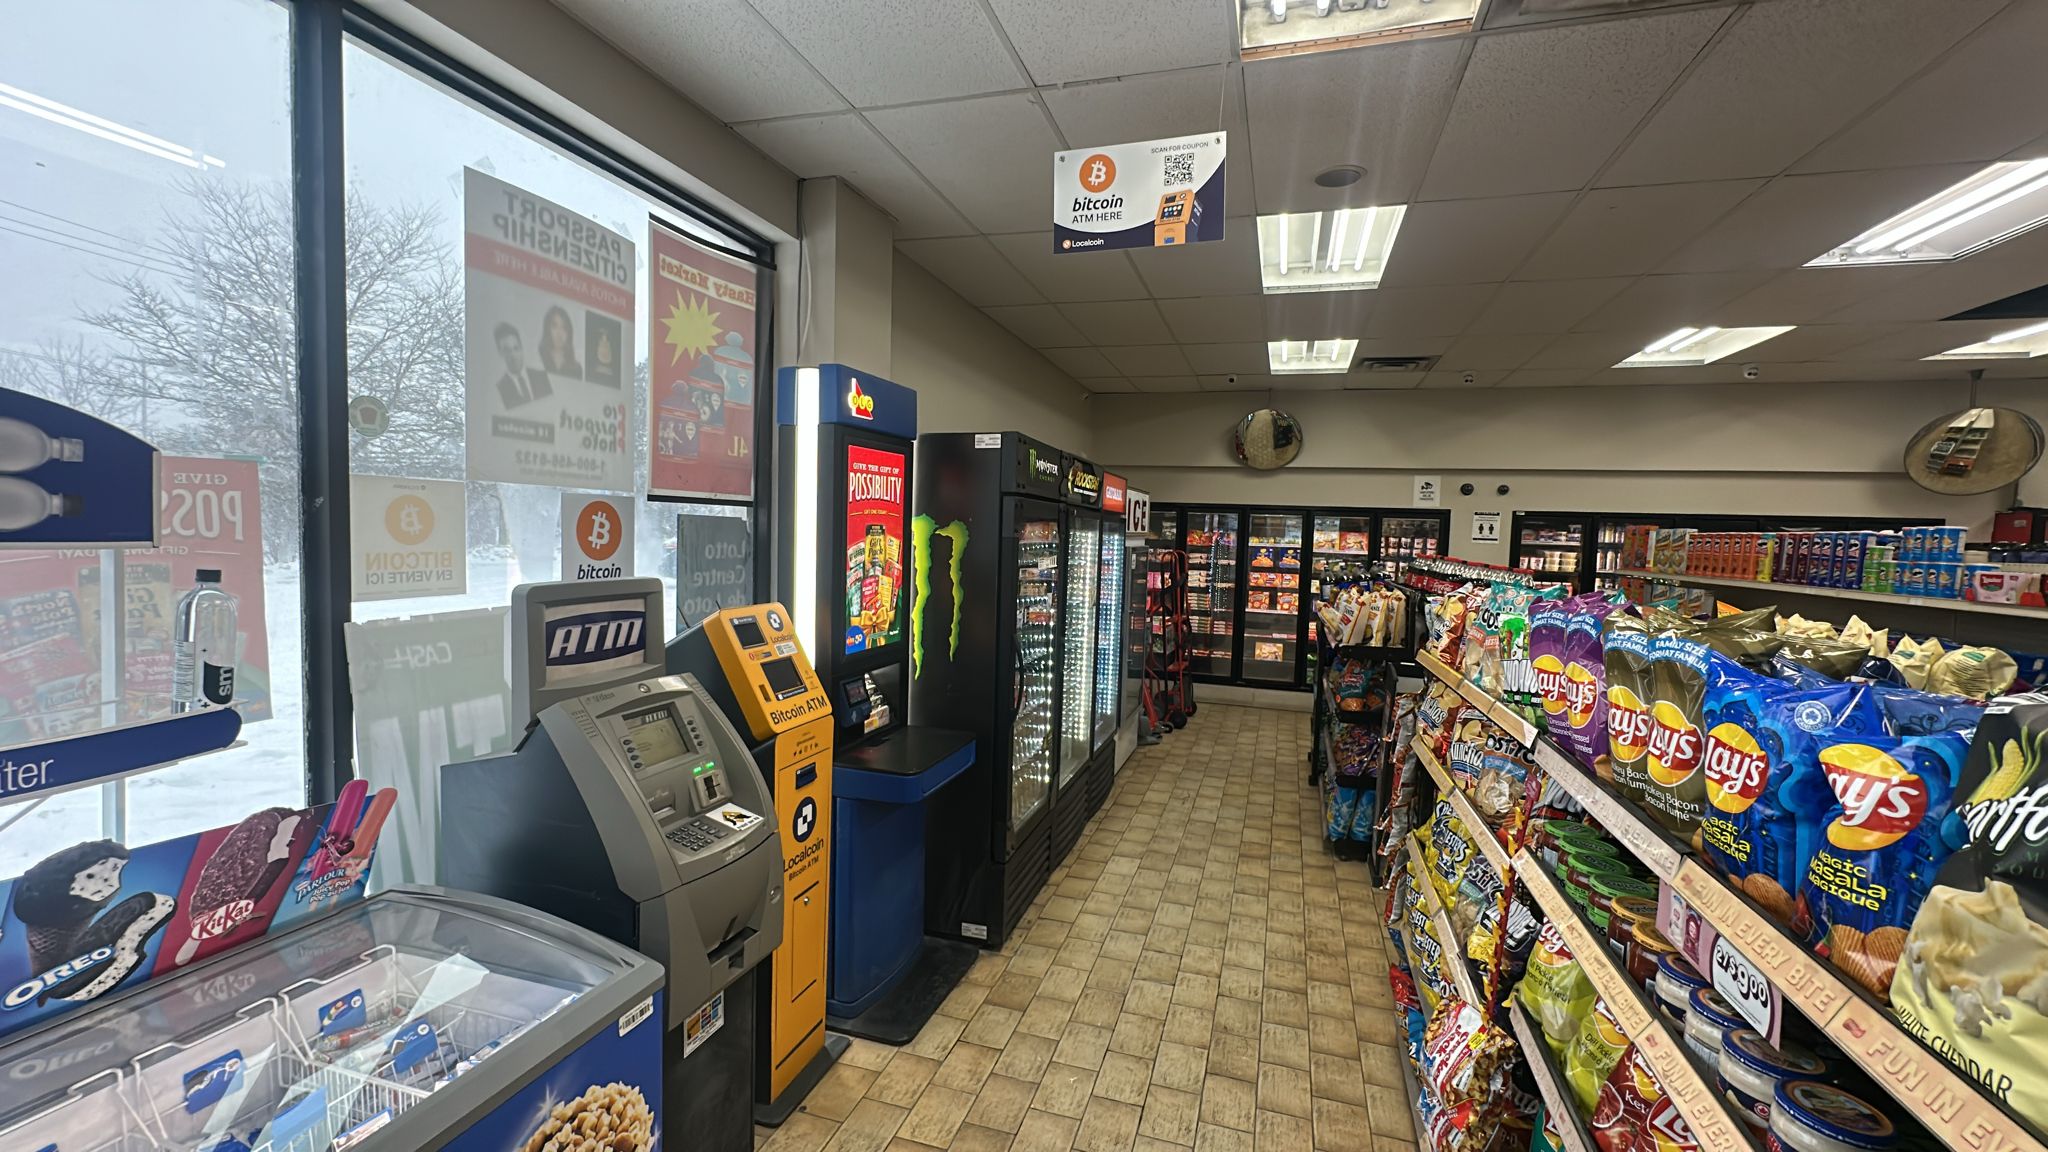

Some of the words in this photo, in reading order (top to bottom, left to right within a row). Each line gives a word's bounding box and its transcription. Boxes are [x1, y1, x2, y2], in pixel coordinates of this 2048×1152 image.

[1151, 146, 1169, 154] SCAN
[1182, 141, 1209, 150] COUPON
[1072, 194, 1123, 212] bitcoin
[1072, 214, 1094, 224] ATM
[1096, 211, 1122, 221] HERE
[1072, 238, 1105, 248] Localcoin
[853, 462, 867, 471] GIVE
[868, 464, 879, 472] THE
[880, 465, 891, 474] GIFT
[1036, 458, 1058, 476] MONSTER
[849, 472, 902, 504] POSSIBILITY
[1127, 498, 1147, 531] ICE
[577, 563, 622, 580] bitcoin
[548, 617, 644, 659] ATM
[1656, 640, 1684, 649] FAMILY
[1685, 642, 1706, 657] SIZE
[1674, 651, 1708, 674] FAMILIAL
[770, 705, 807, 725] Bitcoin
[808, 695, 828, 713] ATM
[1567, 680, 1595, 713] ay's
[0, 759, 54, 793] ter
[1705, 736, 1765, 794] Lay's
[1666, 793, 1699, 812] Bacon
[1822, 764, 1920, 826] ay's
[1666, 803, 1690, 821] fumé
[783, 837, 824, 873] Localcoin
[789, 863, 807, 881] Bitcoin
[807, 855, 819, 870] ATM
[294, 868, 345, 902] PARLOUR
[198, 902, 252, 939] KitKat
[1694, 881, 1720, 913] FUN
[1717, 904, 1738, 927] IN
[1734, 922, 1791, 970] EVERY
[1785, 964, 1837, 1013] BITE
[6, 947, 112, 1008] OREO
[1584, 1033, 1598, 1048] Dill
[1898, 1005, 1929, 1040] WHITE
[1931, 1035, 2013, 1103] CHEDDAR
[1654, 1050, 1687, 1085] FUN
[1674, 1078, 1700, 1104] IN
[1867, 1037, 1929, 1093] FUN
[1923, 1083, 1965, 1124] IN
